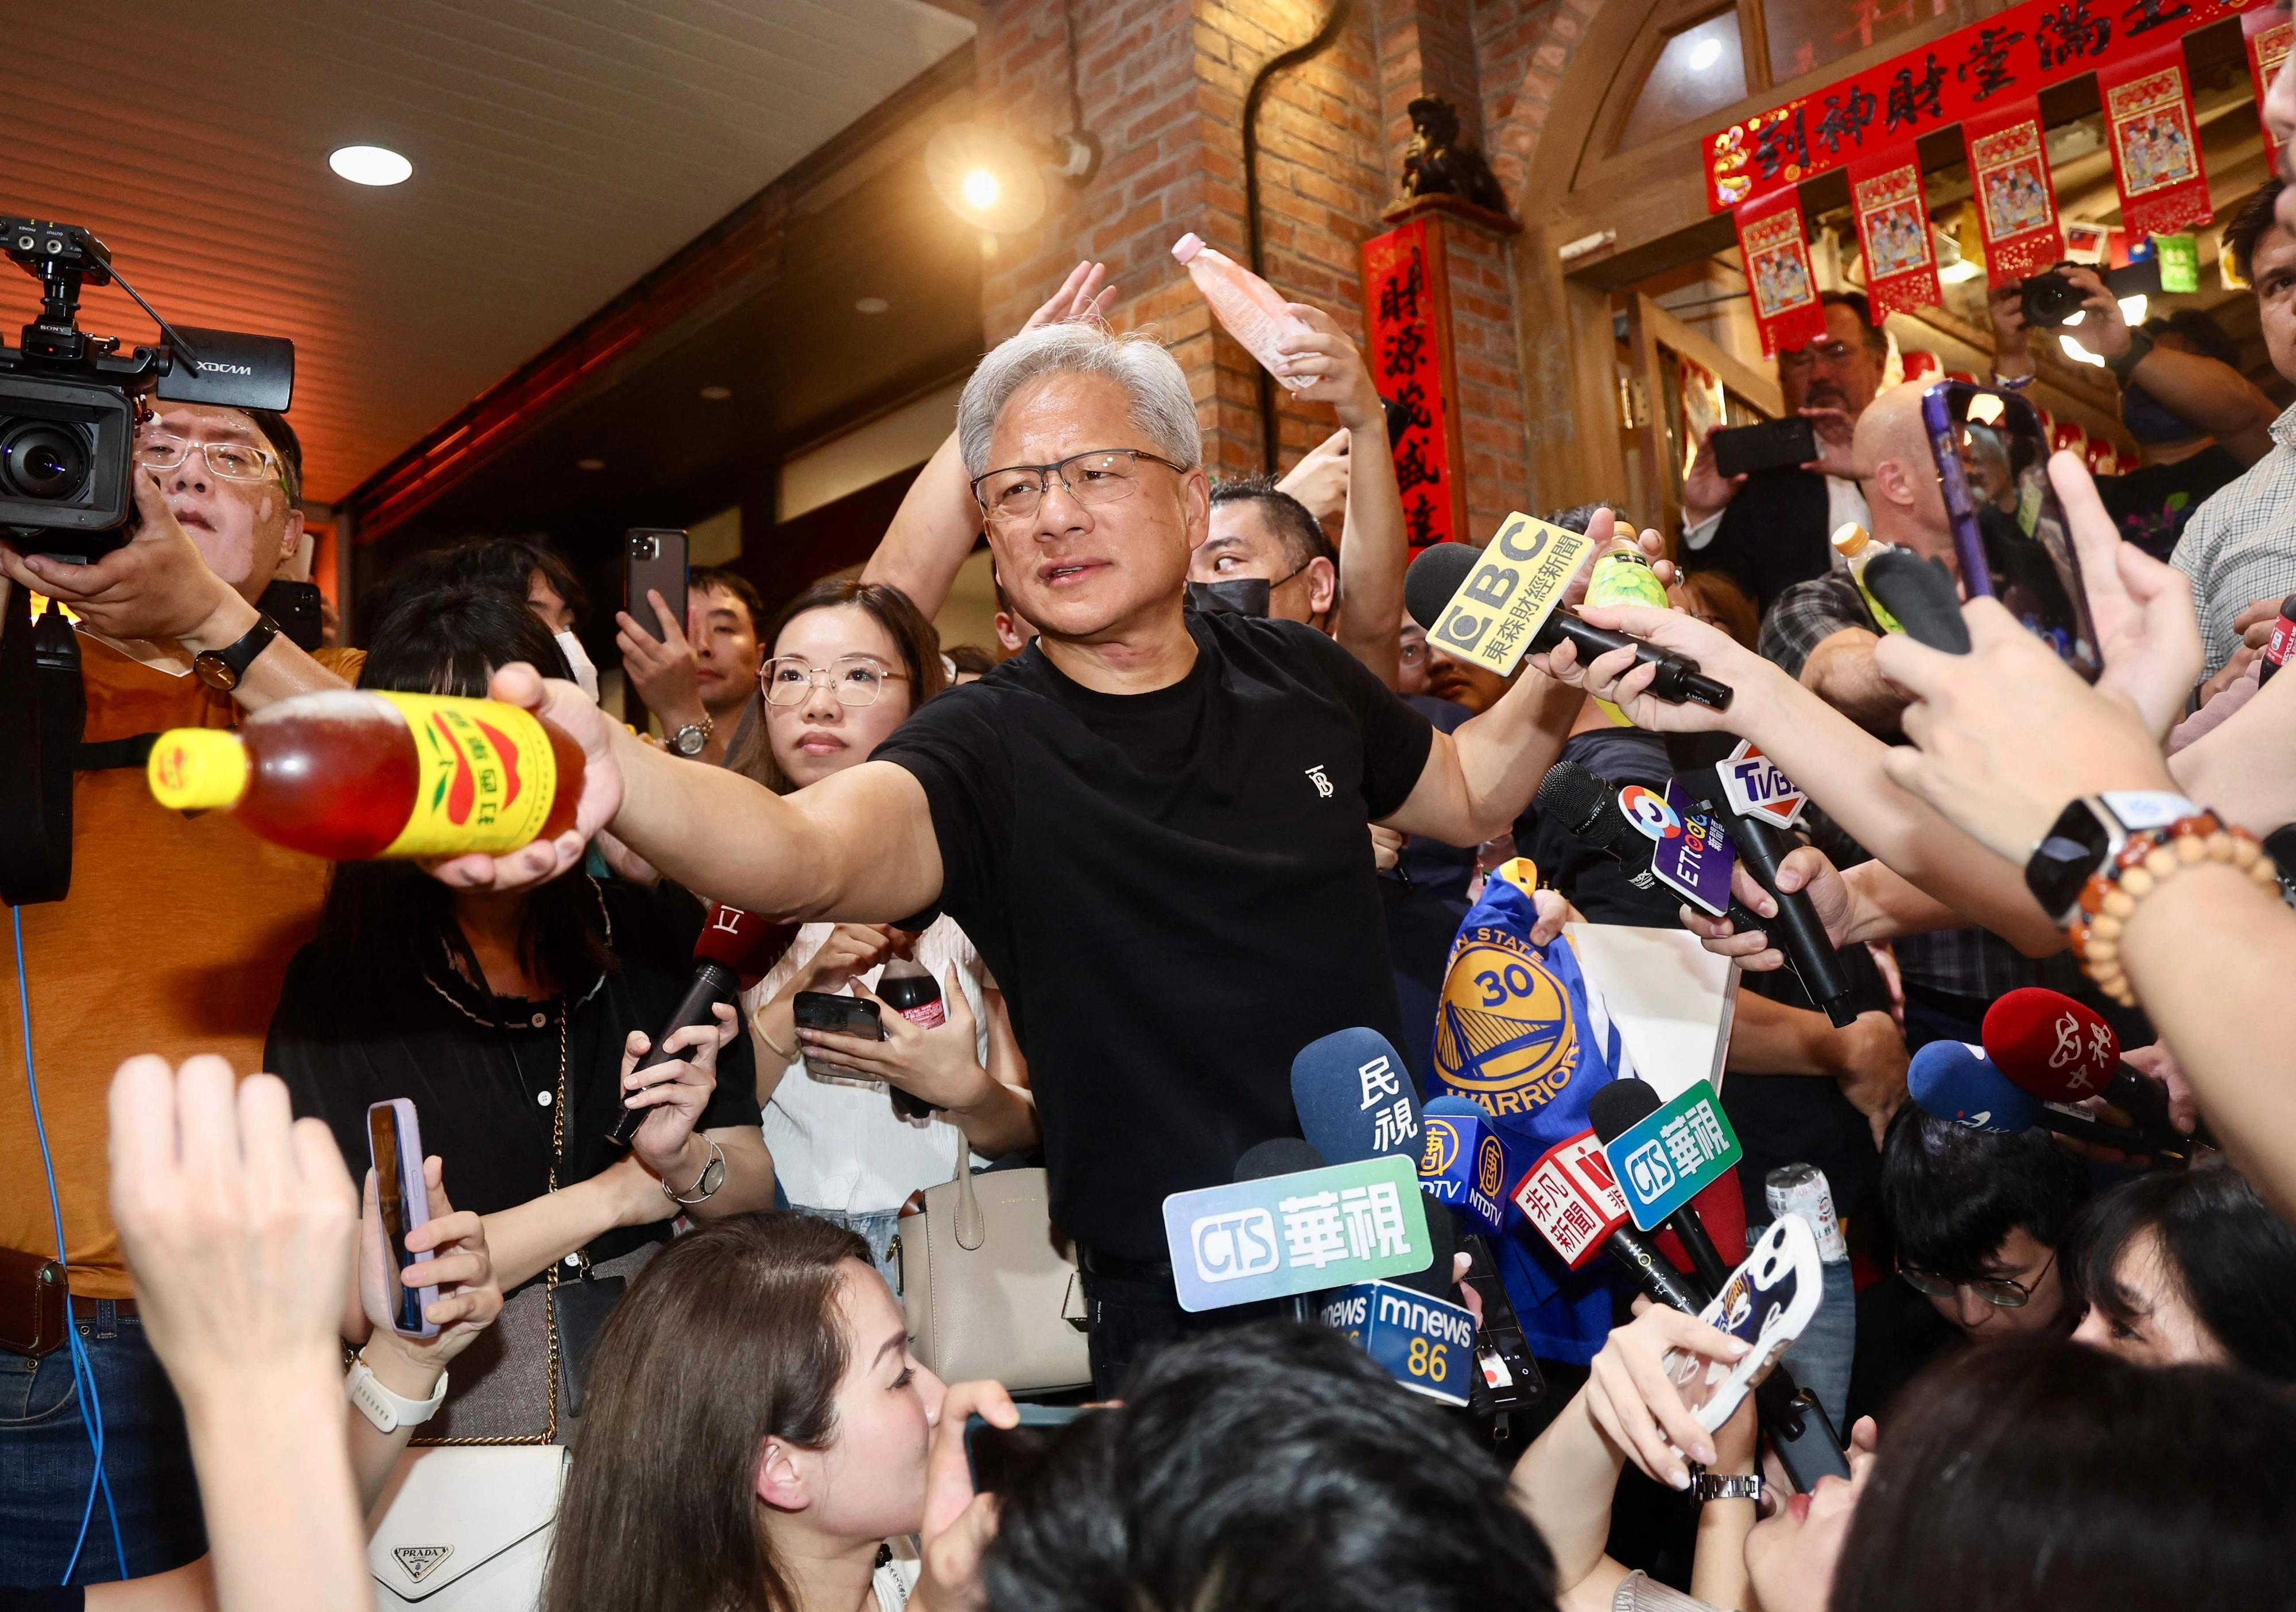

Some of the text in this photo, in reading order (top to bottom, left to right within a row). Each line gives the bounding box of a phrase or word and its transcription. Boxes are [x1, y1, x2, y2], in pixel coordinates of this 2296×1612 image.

[196, 360, 251, 375] XDCAM
[1481, 534, 1584, 664] 東森財經新聞
[2281, 636, 2294, 666] RECYCLE
[1686, 692, 1710, 705] SONY
[1735, 762, 1799, 802] TVB
[712, 905, 744, 934] 立
[1477, 927, 1544, 963] STATE
[1473, 964, 1534, 1007] 30
[1358, 1055, 1418, 1152] 民視
[1659, 1098, 1731, 1178] 華視
[1419, 1180, 1461, 1198] DTV
[1631, 1144, 1671, 1197] CTS
[1469, 1187, 1502, 1226] NTDTV
[1525, 1172, 1569, 1222] 非凡
[1199, 1215, 1273, 1275] CTS
[1278, 1182, 1411, 1269] 華視
[1550, 1201, 1596, 1253] 新聞
[1379, 1295, 1471, 1348] mnews
[1407, 1337, 1448, 1382] 86
